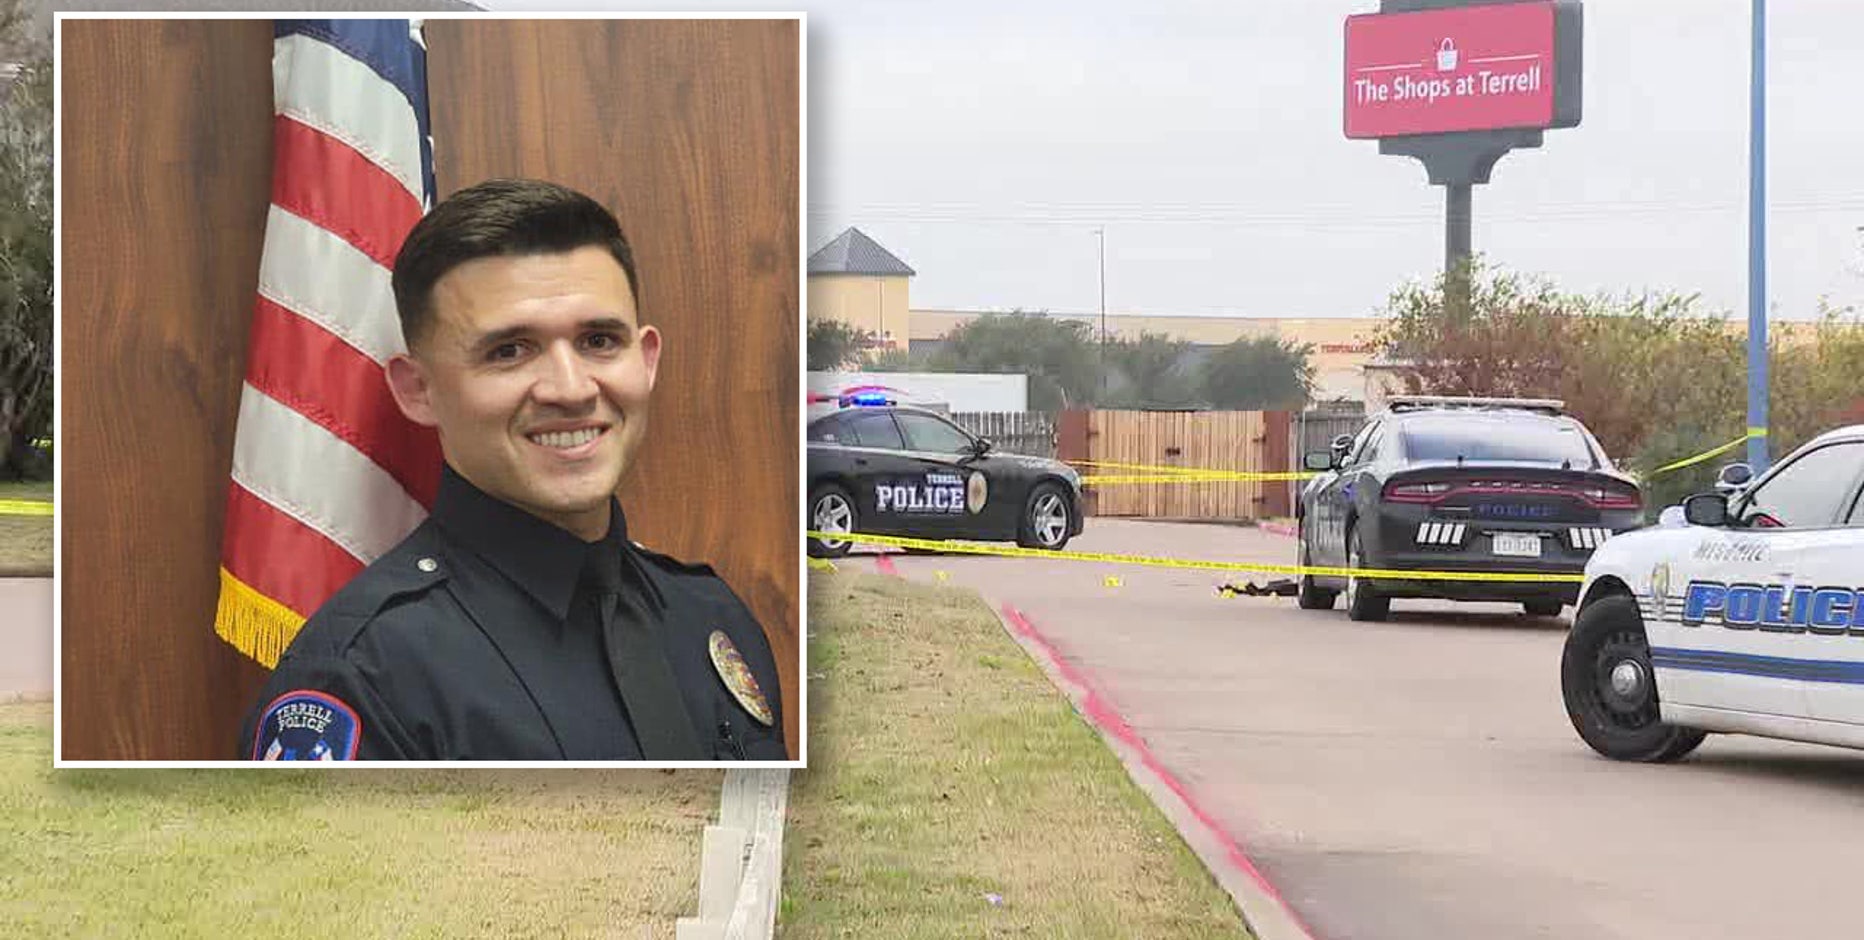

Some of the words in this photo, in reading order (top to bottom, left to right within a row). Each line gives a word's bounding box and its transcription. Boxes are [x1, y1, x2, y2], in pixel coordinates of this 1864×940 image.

[1355, 80, 1388, 103] The
[1393, 76, 1450, 103] Shops
[1456, 76, 1475, 95] at
[1479, 65, 1541, 94] Terrell
[875, 484, 965, 511] POLICE
[276, 702, 333, 723] TERRELL
[279, 716, 326, 733] POLICE
